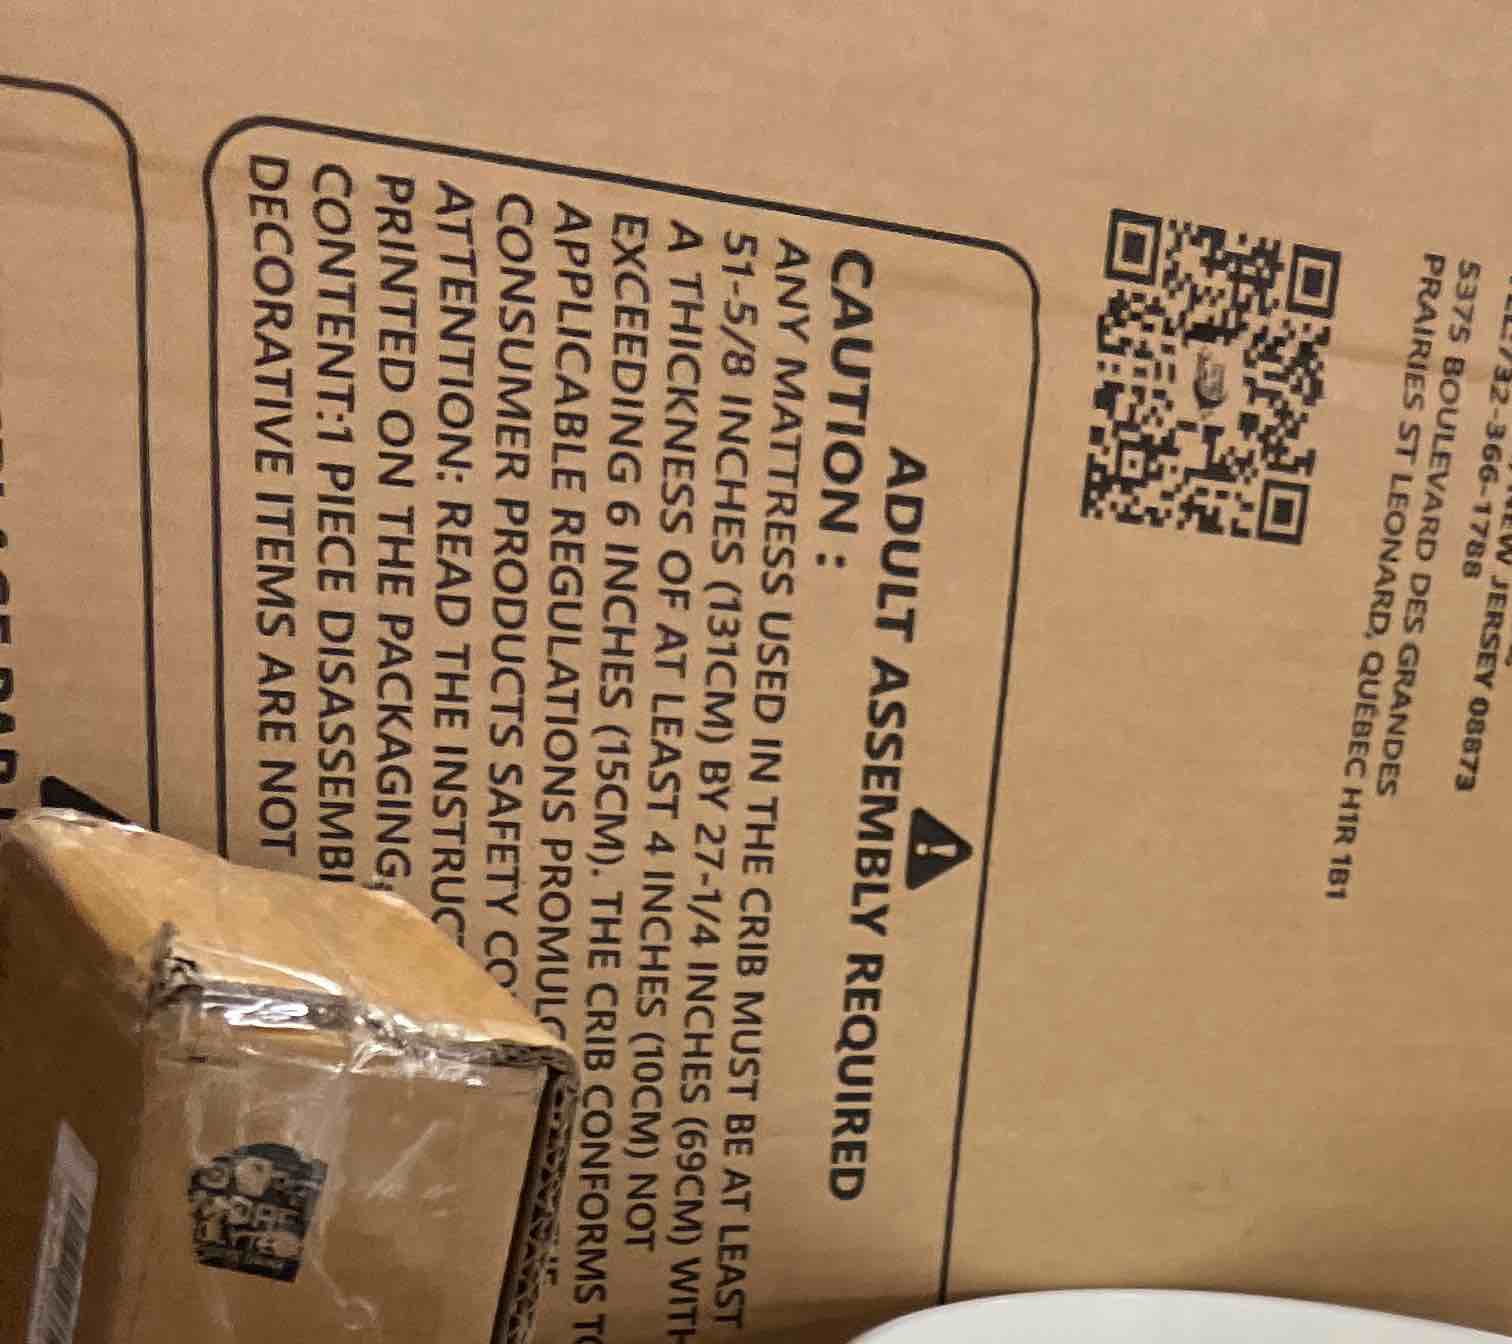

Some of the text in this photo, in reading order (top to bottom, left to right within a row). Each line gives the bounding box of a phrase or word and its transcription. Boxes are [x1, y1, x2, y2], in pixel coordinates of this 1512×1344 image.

[374, 173, 419, 393] PRINTED
[434, 179, 478, 484] ATTENTION:
[494, 192, 537, 481] CONSUMER
[550, 200, 594, 493] APPLICABLE
[606, 212, 651, 484] EXCEEDING
[1402, 252, 1447, 411] PRAIRIES
[376, 409, 416, 489] ON
[818, 248, 876, 535] CAUTION
[1395, 420, 1421, 465] ST
[247, 154, 298, 872] DECORATIVE ITEMS ARE NOT
[316, 461, 356, 594] PIECE
[376, 504, 416, 598] THE
[605, 500, 641, 527] 6
[710, 393, 753, 565] INCHES
[1363, 472, 1414, 640] LEONARD,
[1376, 258, 1483, 797] 5375 BOULEVARD DES GRANDES
[434, 500, 474, 628] READ
[488, 497, 531, 748] PRODUCTS
[598, 542, 640, 709] INCHES
[1473, 574, 1509, 691] JERSEY
[433, 642, 472, 730] THE
[541, 507, 587, 823] REGULATIONS
[623, 218, 705, 1253] A THICKNESS OF AT LEAST 4 INCHES (10CM) NOT
[694, 580, 743, 744] (131CM)
[585, 724, 632, 878] (15CM).
[697, 760, 732, 812] BY
[714, 236, 811, 1329] ANY MATTRESS USED IN THE CRIB MUST BE AT LEAST
[828, 445, 928, 1201] ADULT ASSEMBLY REQUIRED
[1333, 786, 1364, 845] H1R
[1454, 696, 1491, 793] 08873
[484, 762, 524, 917] SAFETY
[1324, 853, 1353, 900] 1B1
[587, 890, 624, 970] THE
[583, 982, 619, 1072] CRIB
[679, 961, 719, 1104] INCHES
[573, 1084, 614, 1304] CONFORMS
[665, 1116, 709, 1246] (69CM)
